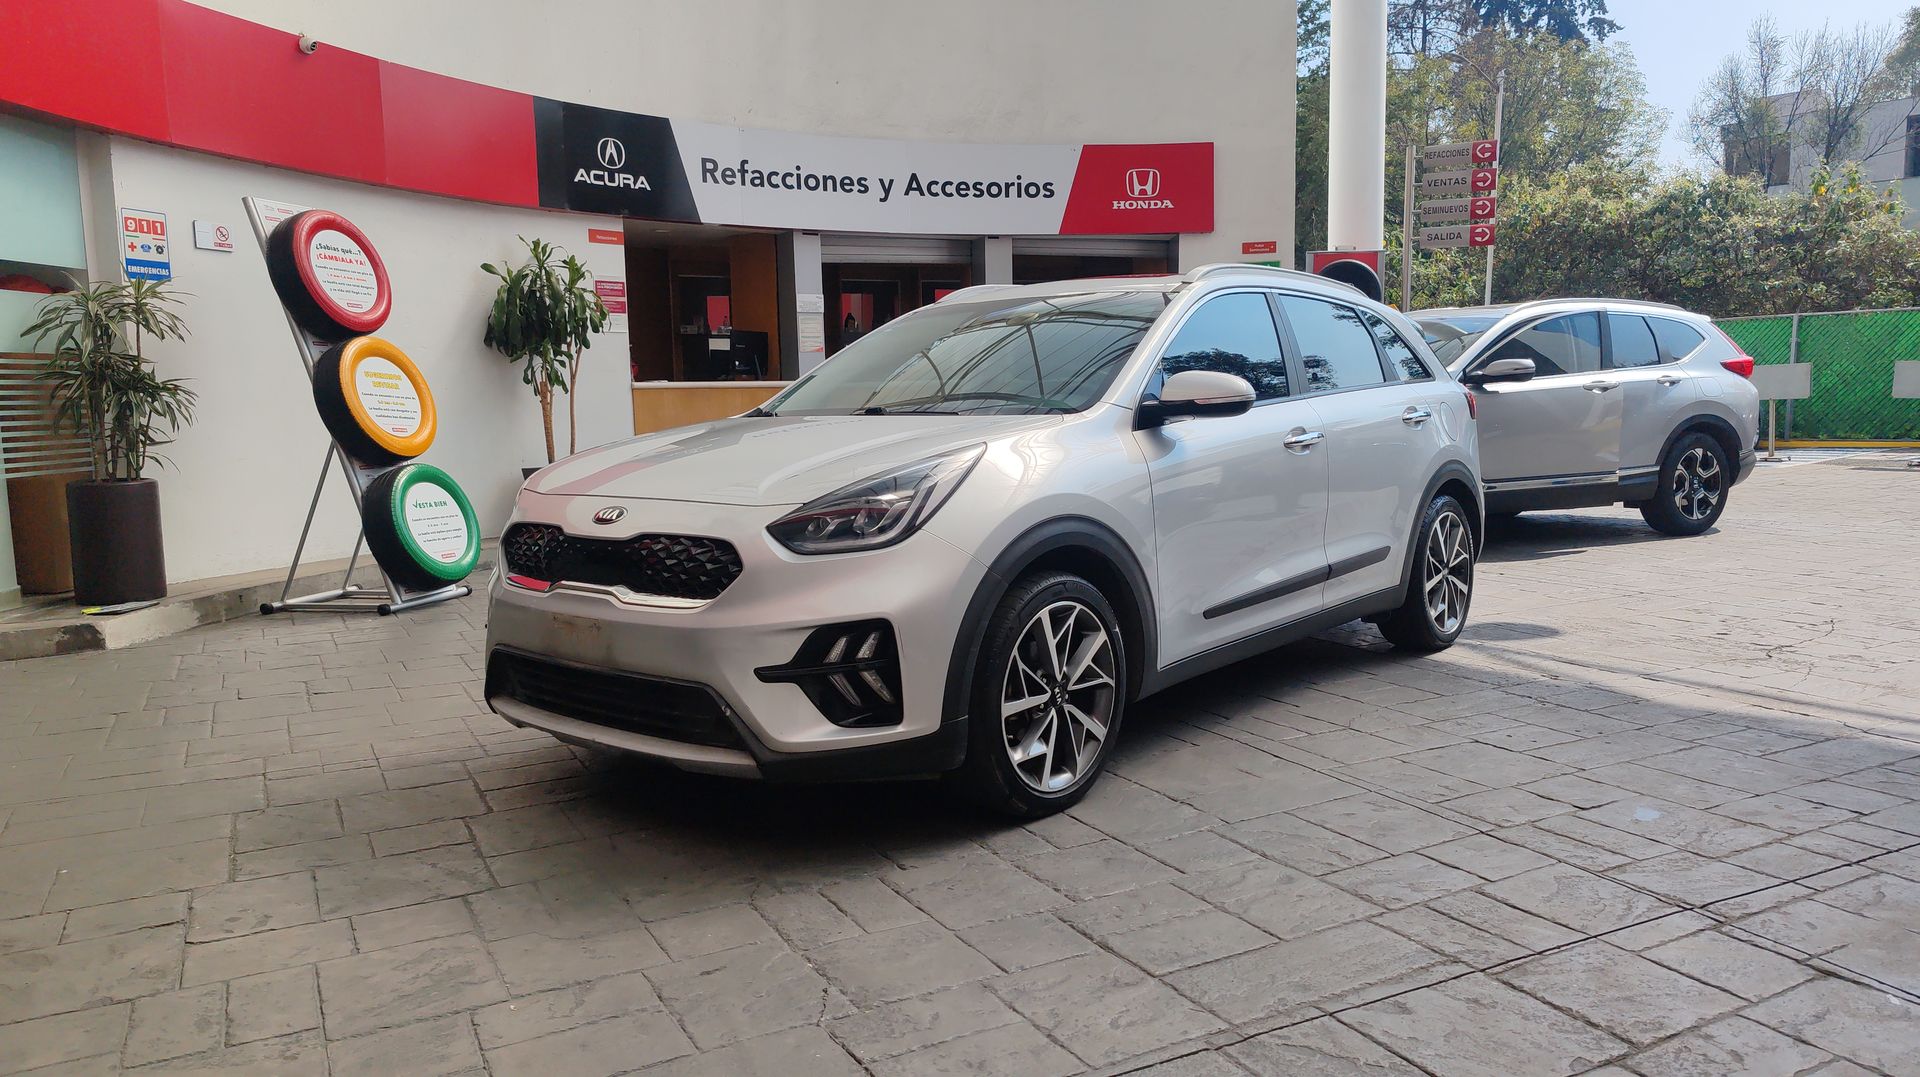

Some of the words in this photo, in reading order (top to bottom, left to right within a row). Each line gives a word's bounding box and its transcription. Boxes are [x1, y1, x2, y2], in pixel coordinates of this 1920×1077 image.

[1424, 148, 1470, 159] REFACCIONES
[574, 168, 651, 191] ACURA
[701, 157, 869, 194] Refacciones
[878, 174, 894, 202] y
[904, 172, 1056, 199] Accesorios
[1427, 177, 1467, 187] VENTAS
[1112, 199, 1175, 210] HONDA
[1423, 205, 1469, 215] SEMINUEVOS
[127, 221, 162, 234] 911
[1427, 232, 1463, 242] SALIDA
[127, 265, 170, 276] EMERGENCIAS
[595, 508, 620, 519] KIA
